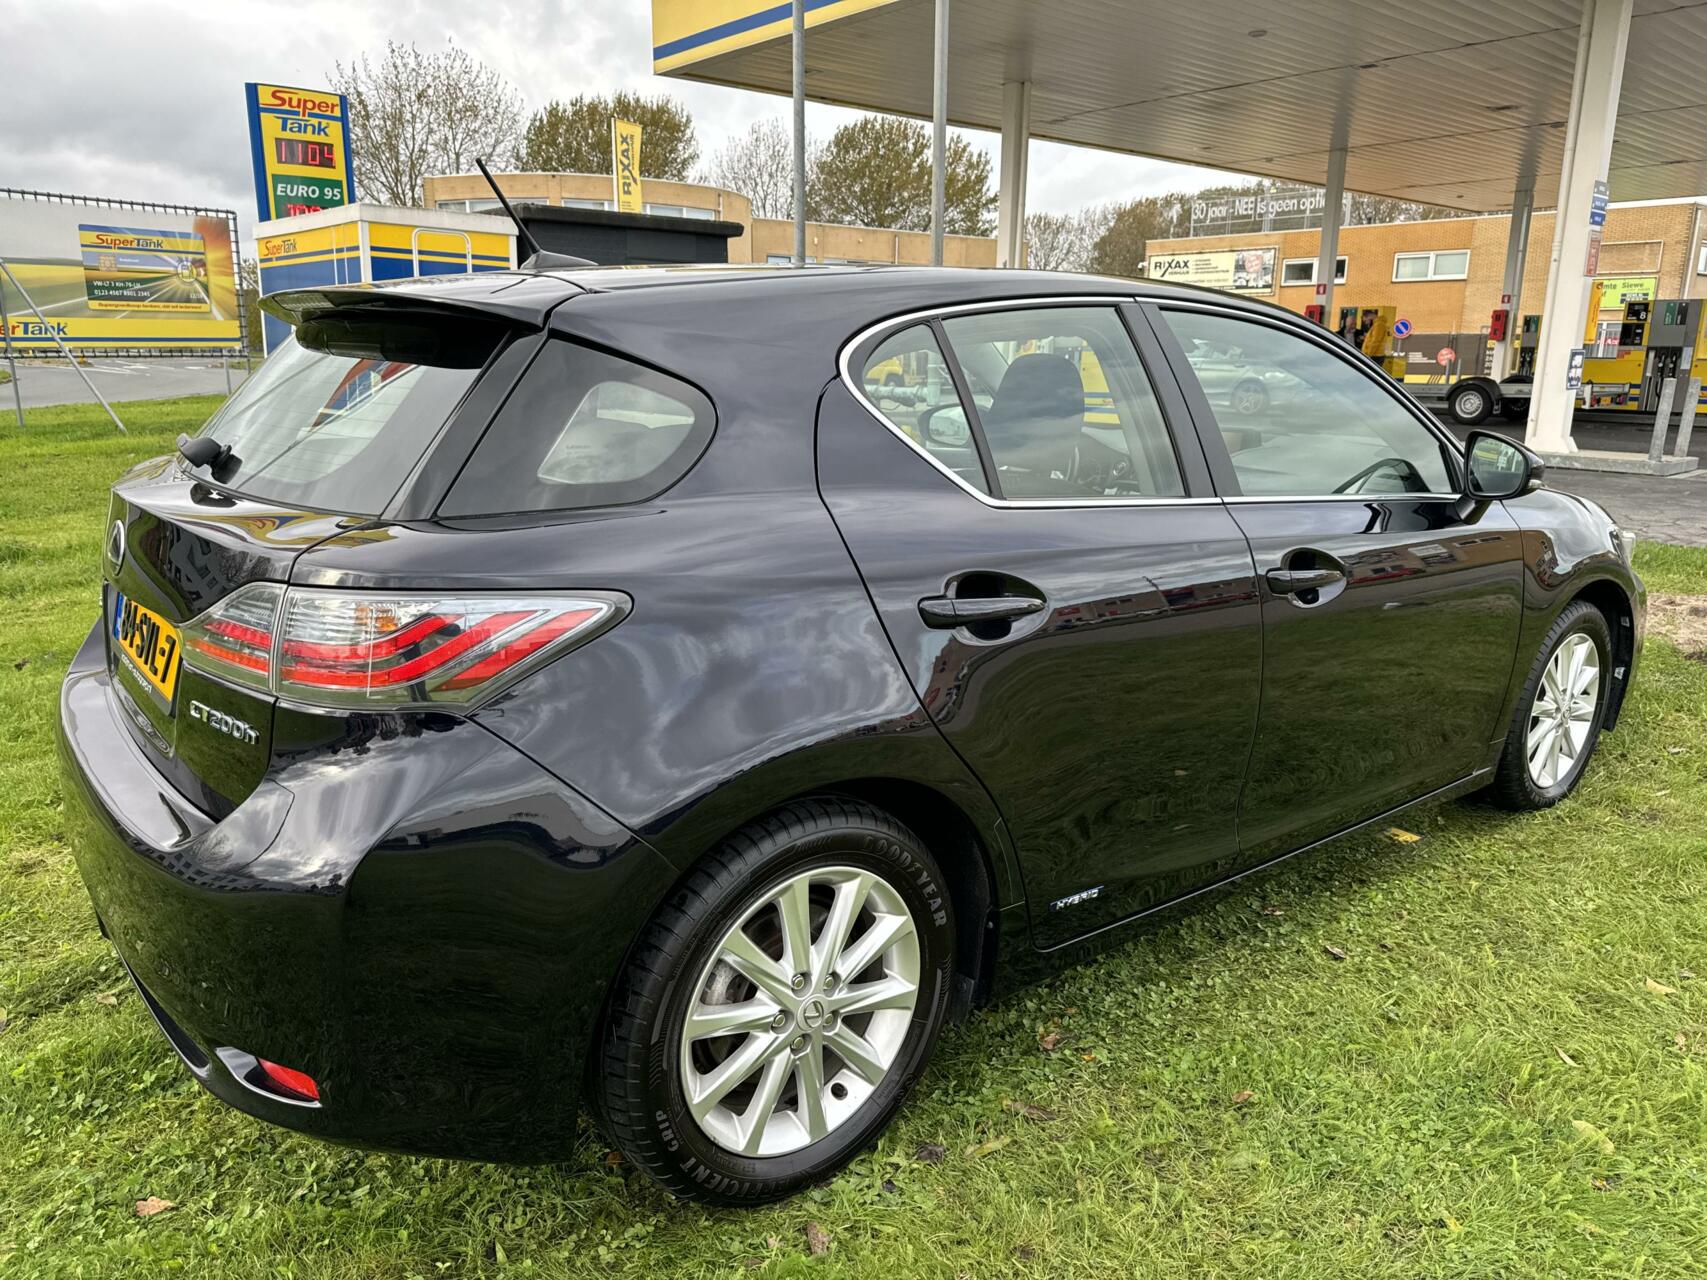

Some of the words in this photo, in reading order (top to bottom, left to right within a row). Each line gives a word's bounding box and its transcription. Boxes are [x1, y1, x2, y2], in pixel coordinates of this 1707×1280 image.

[259, 89, 340, 117] Super
[274, 115, 330, 137] Tank
[276, 183, 320, 199] EURO
[323, 187, 342, 201] 95
[1192, 201, 1206, 219] 30
[1207, 203, 1228, 223] jaar
[1235, 198, 1255, 215] NEE
[1269, 199, 1298, 217] geen
[90, 233, 164, 251] SuperTank
[263, 238, 298, 257] SuperTank
[1154, 259, 1190, 277] RIXAX
[190, 700, 260, 745] CT200h
